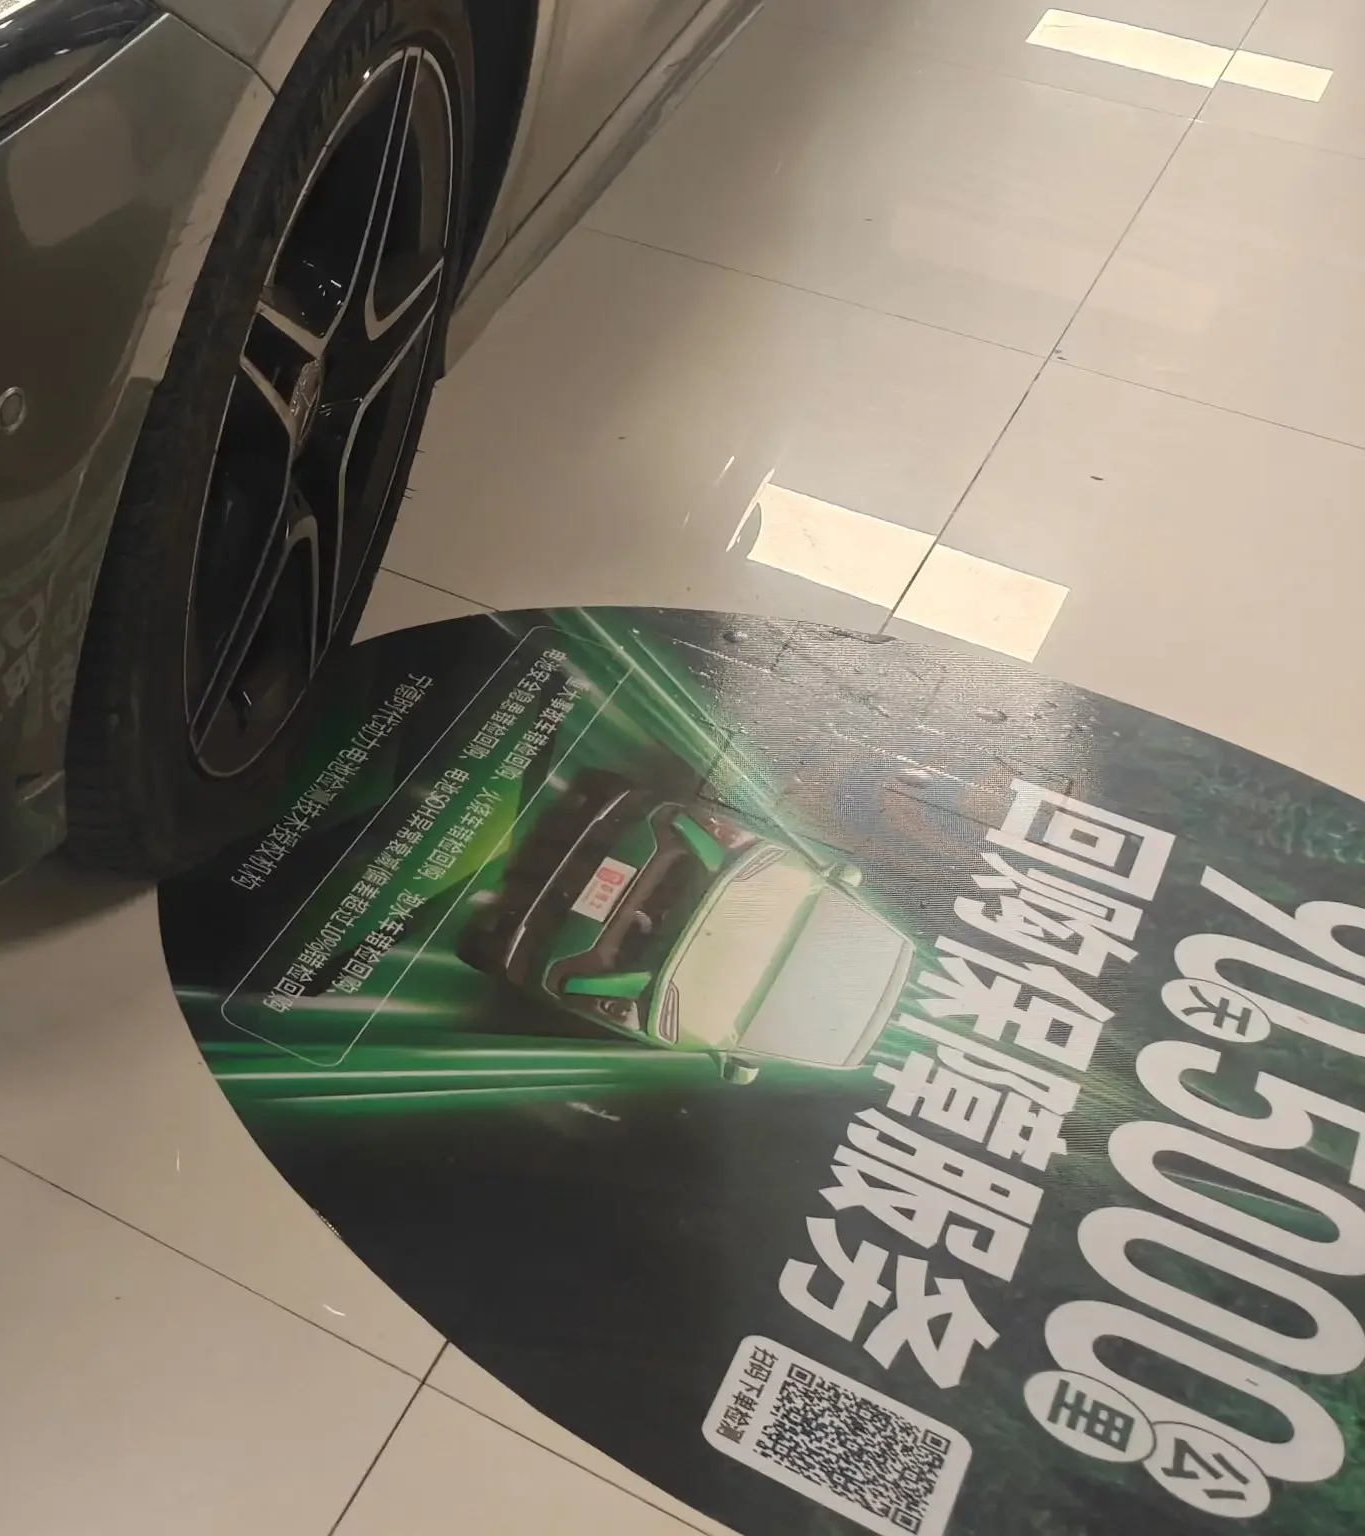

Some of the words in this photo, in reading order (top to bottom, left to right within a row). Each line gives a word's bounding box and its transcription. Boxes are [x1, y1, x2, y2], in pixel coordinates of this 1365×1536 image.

[777, 777, 1177, 1390] 回购保障服务
